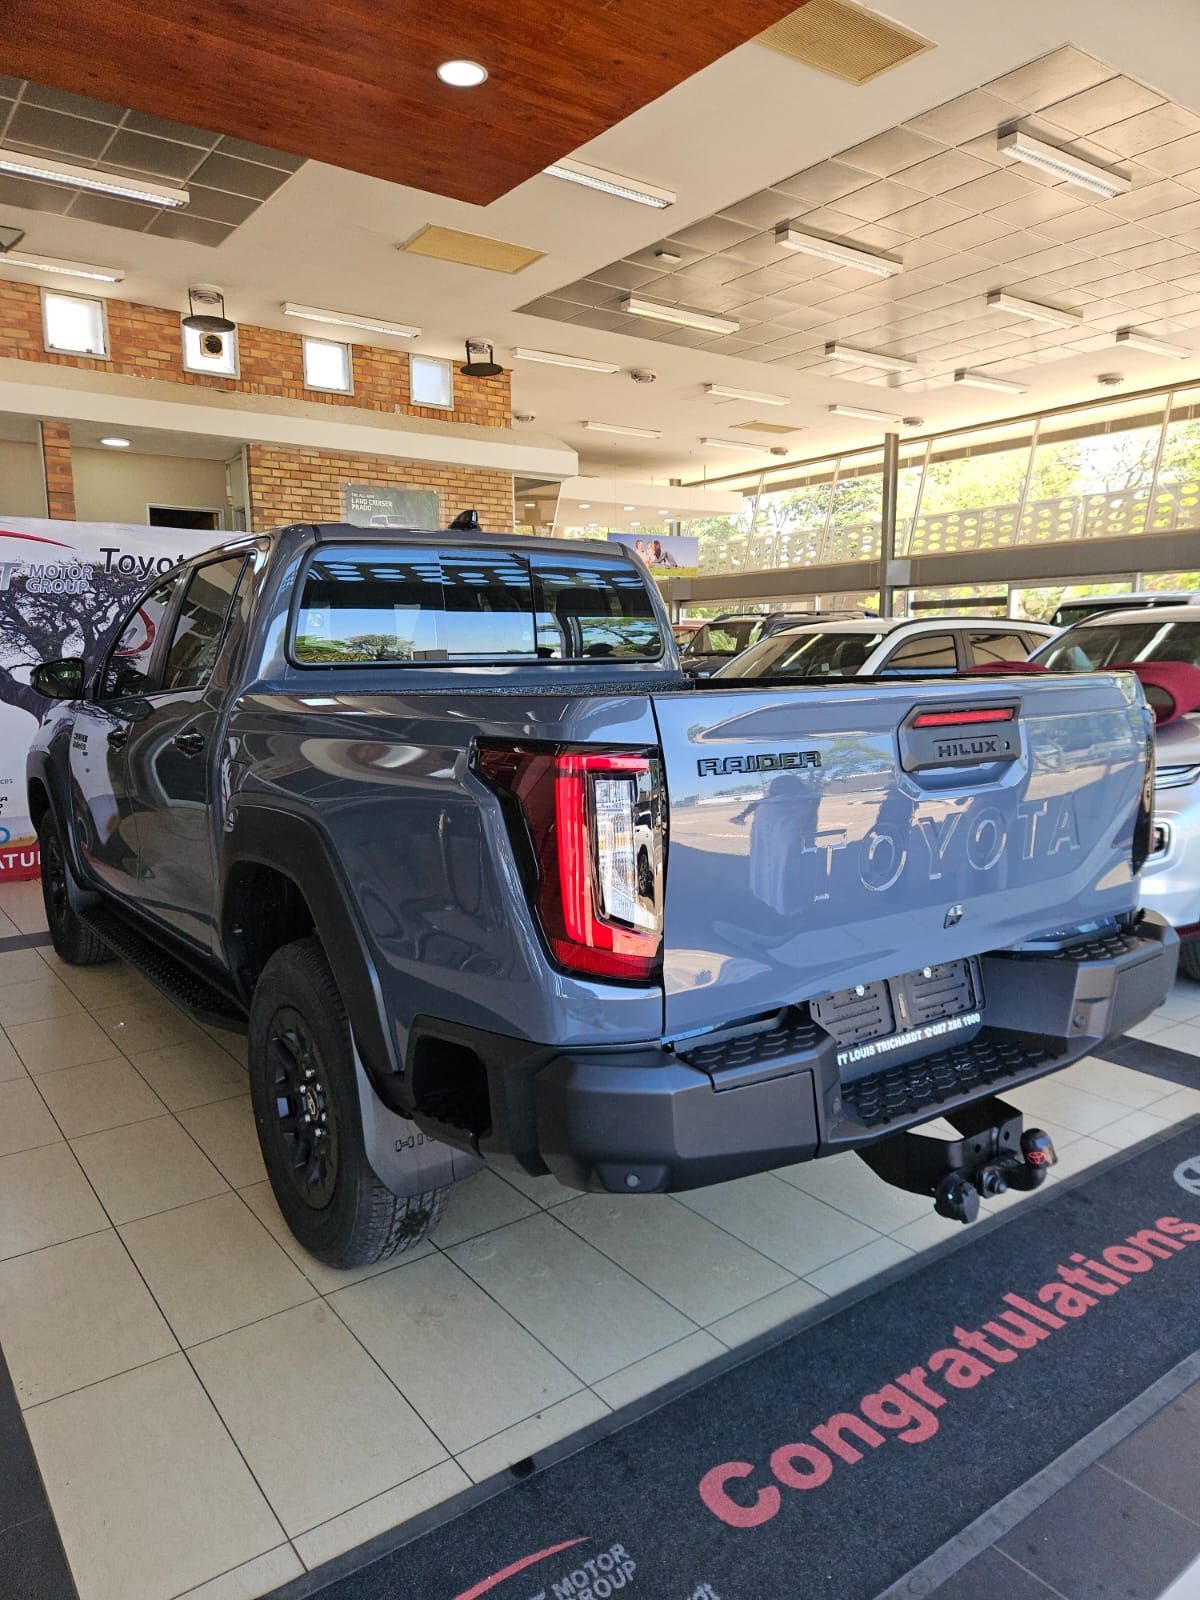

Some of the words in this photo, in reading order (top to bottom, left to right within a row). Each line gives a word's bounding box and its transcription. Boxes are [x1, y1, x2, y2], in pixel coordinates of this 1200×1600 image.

[25, 578, 90, 594] GROUP
[28, 564, 94, 580] MOTOR
[697, 750, 822, 777] RAIDER
[938, 740, 997, 758] HILUX
[801, 798, 1081, 902] TOYOTA
[849, 1045, 876, 1062] LOUIS
[876, 1030, 921, 1053] TRICHARDT
[699, 1215, 1200, 1528] Congratulations
[551, 1543, 630, 1600] MOTOR
